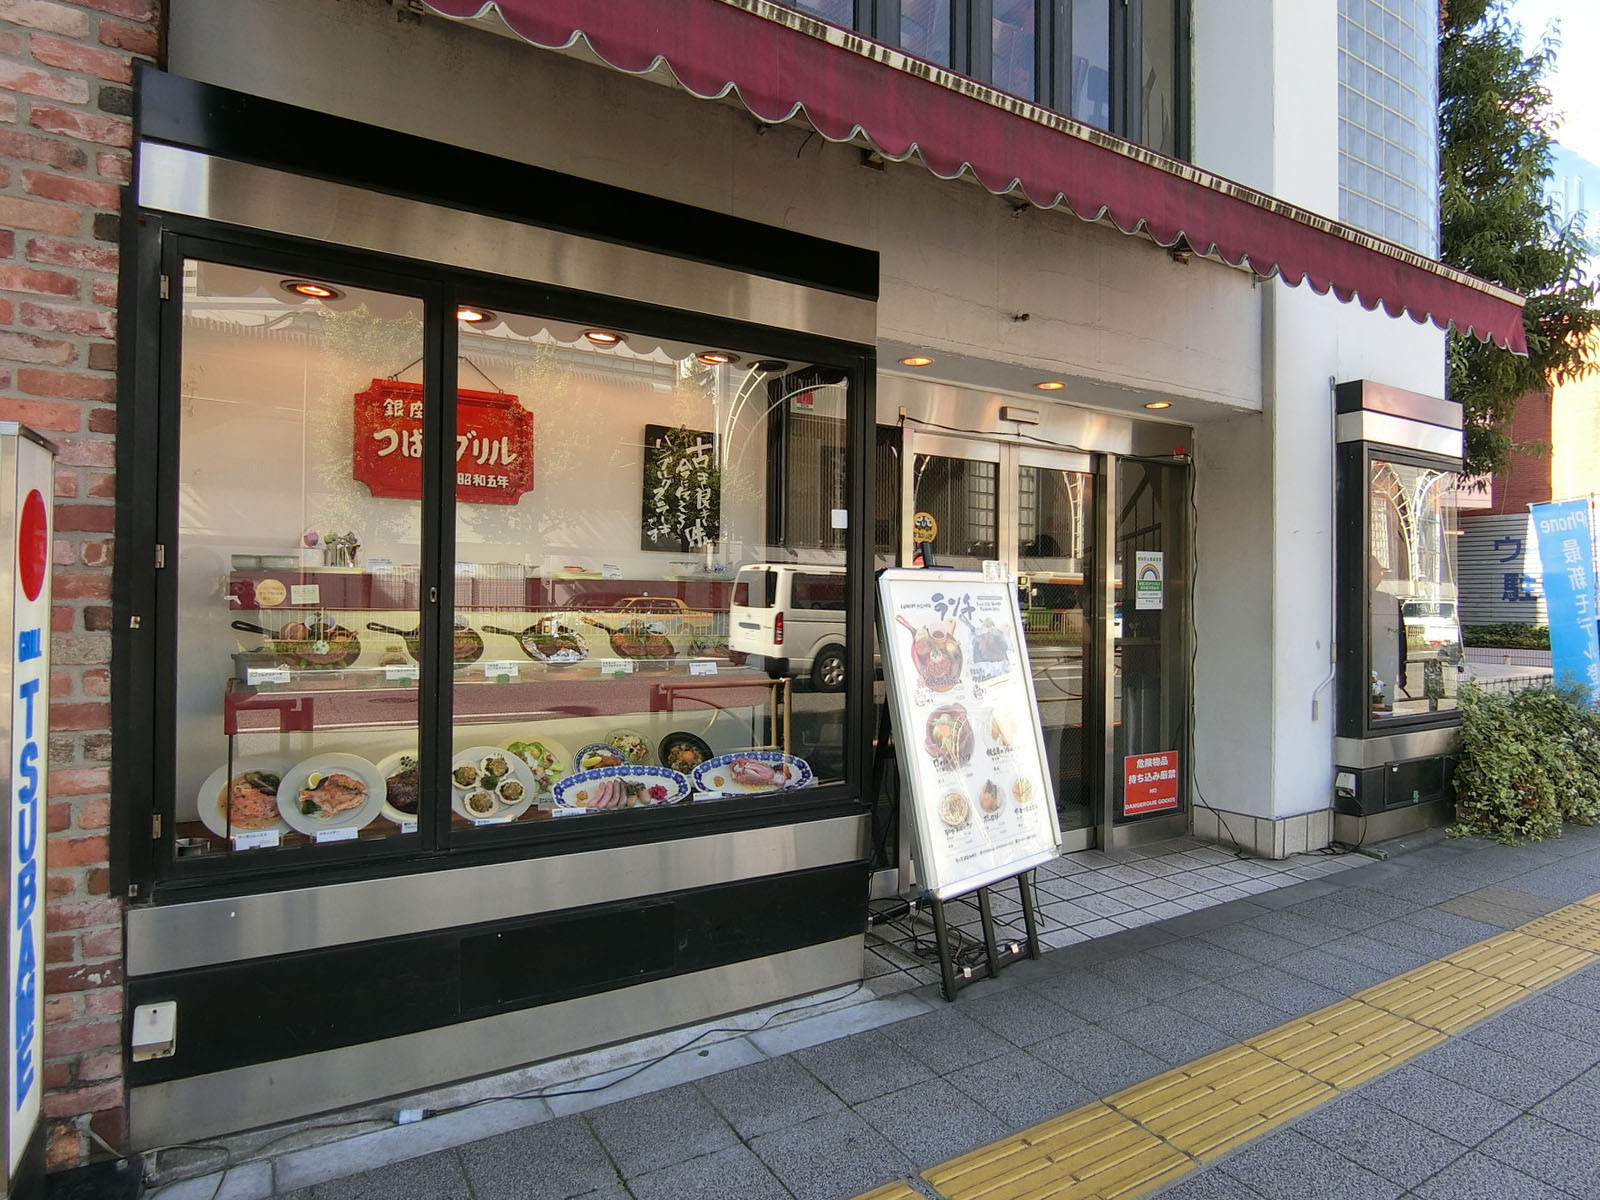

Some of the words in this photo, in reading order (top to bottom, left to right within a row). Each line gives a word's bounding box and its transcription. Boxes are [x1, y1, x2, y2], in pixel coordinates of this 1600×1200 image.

[457, 472, 509, 488] 昭和五年
[15, 678, 40, 1112] TSUBAME
